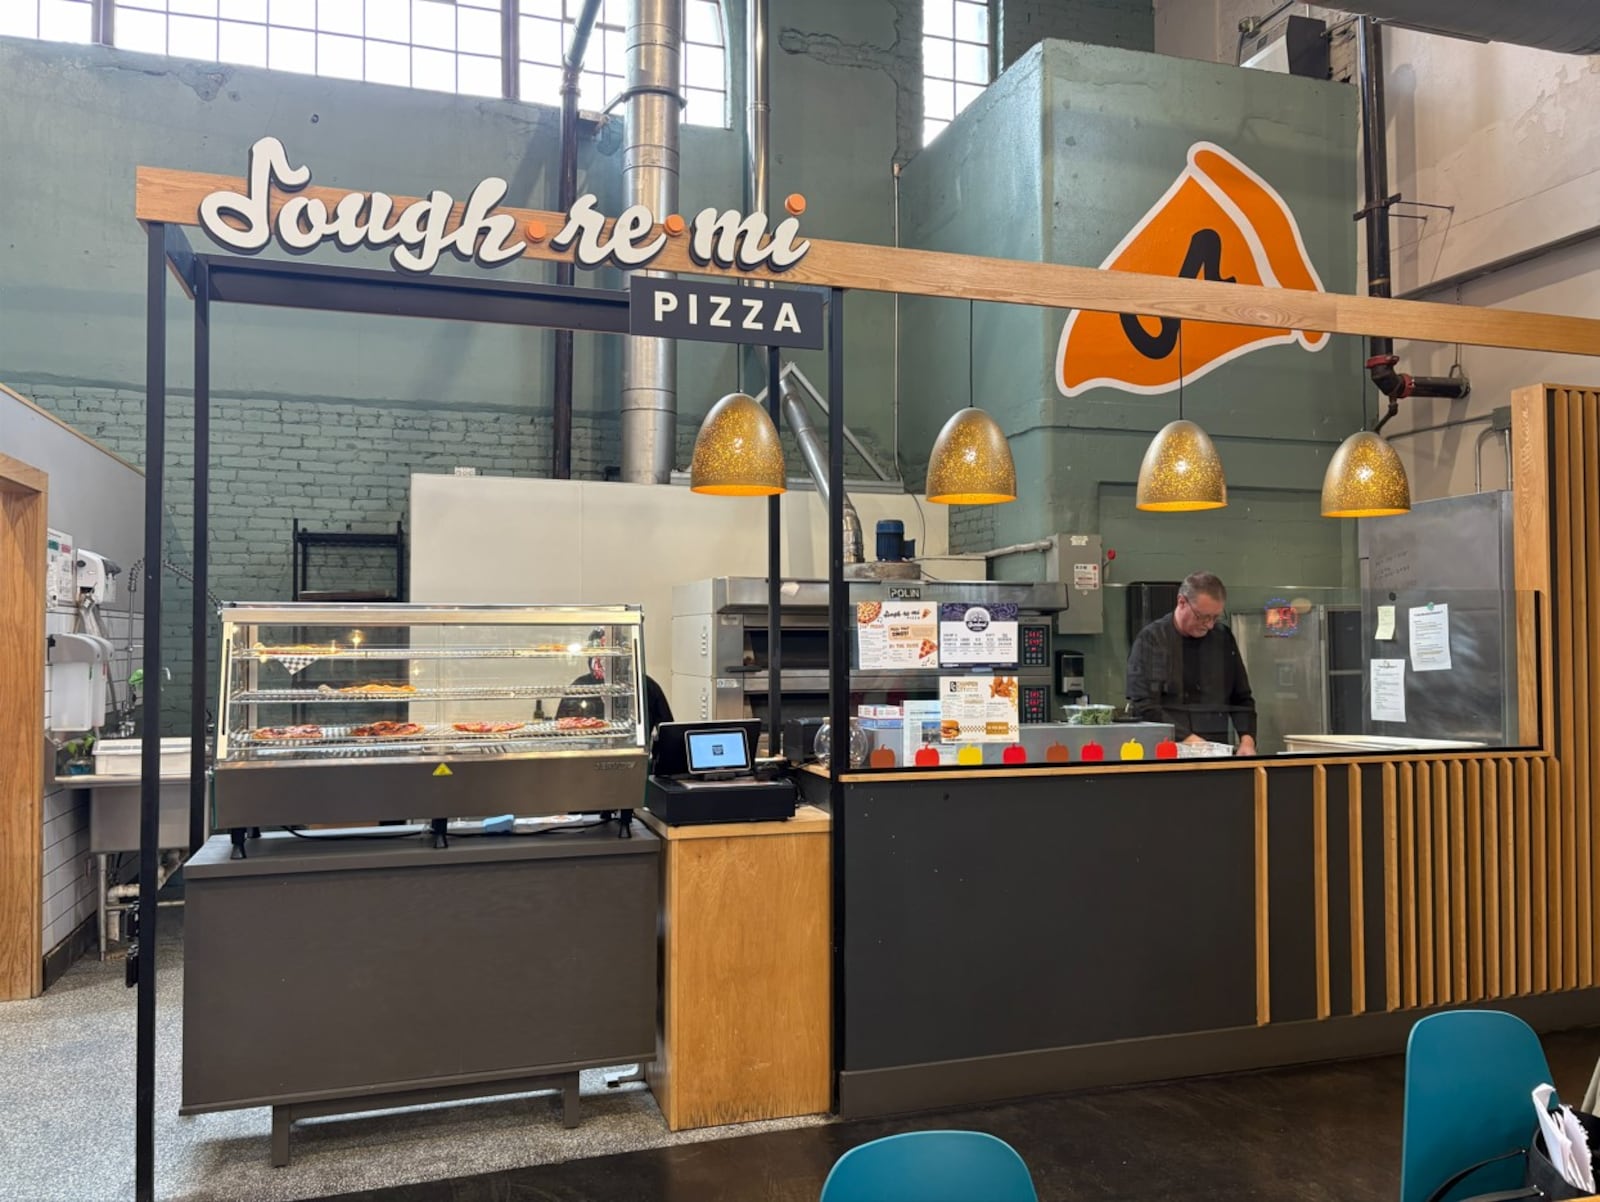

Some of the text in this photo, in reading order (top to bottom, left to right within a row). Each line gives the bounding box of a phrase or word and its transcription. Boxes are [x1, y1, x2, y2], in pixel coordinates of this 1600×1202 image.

[200, 136, 811, 272] dough re mi
[653, 290, 802, 333] PIZZA
[890, 588, 921, 598] POLIN
